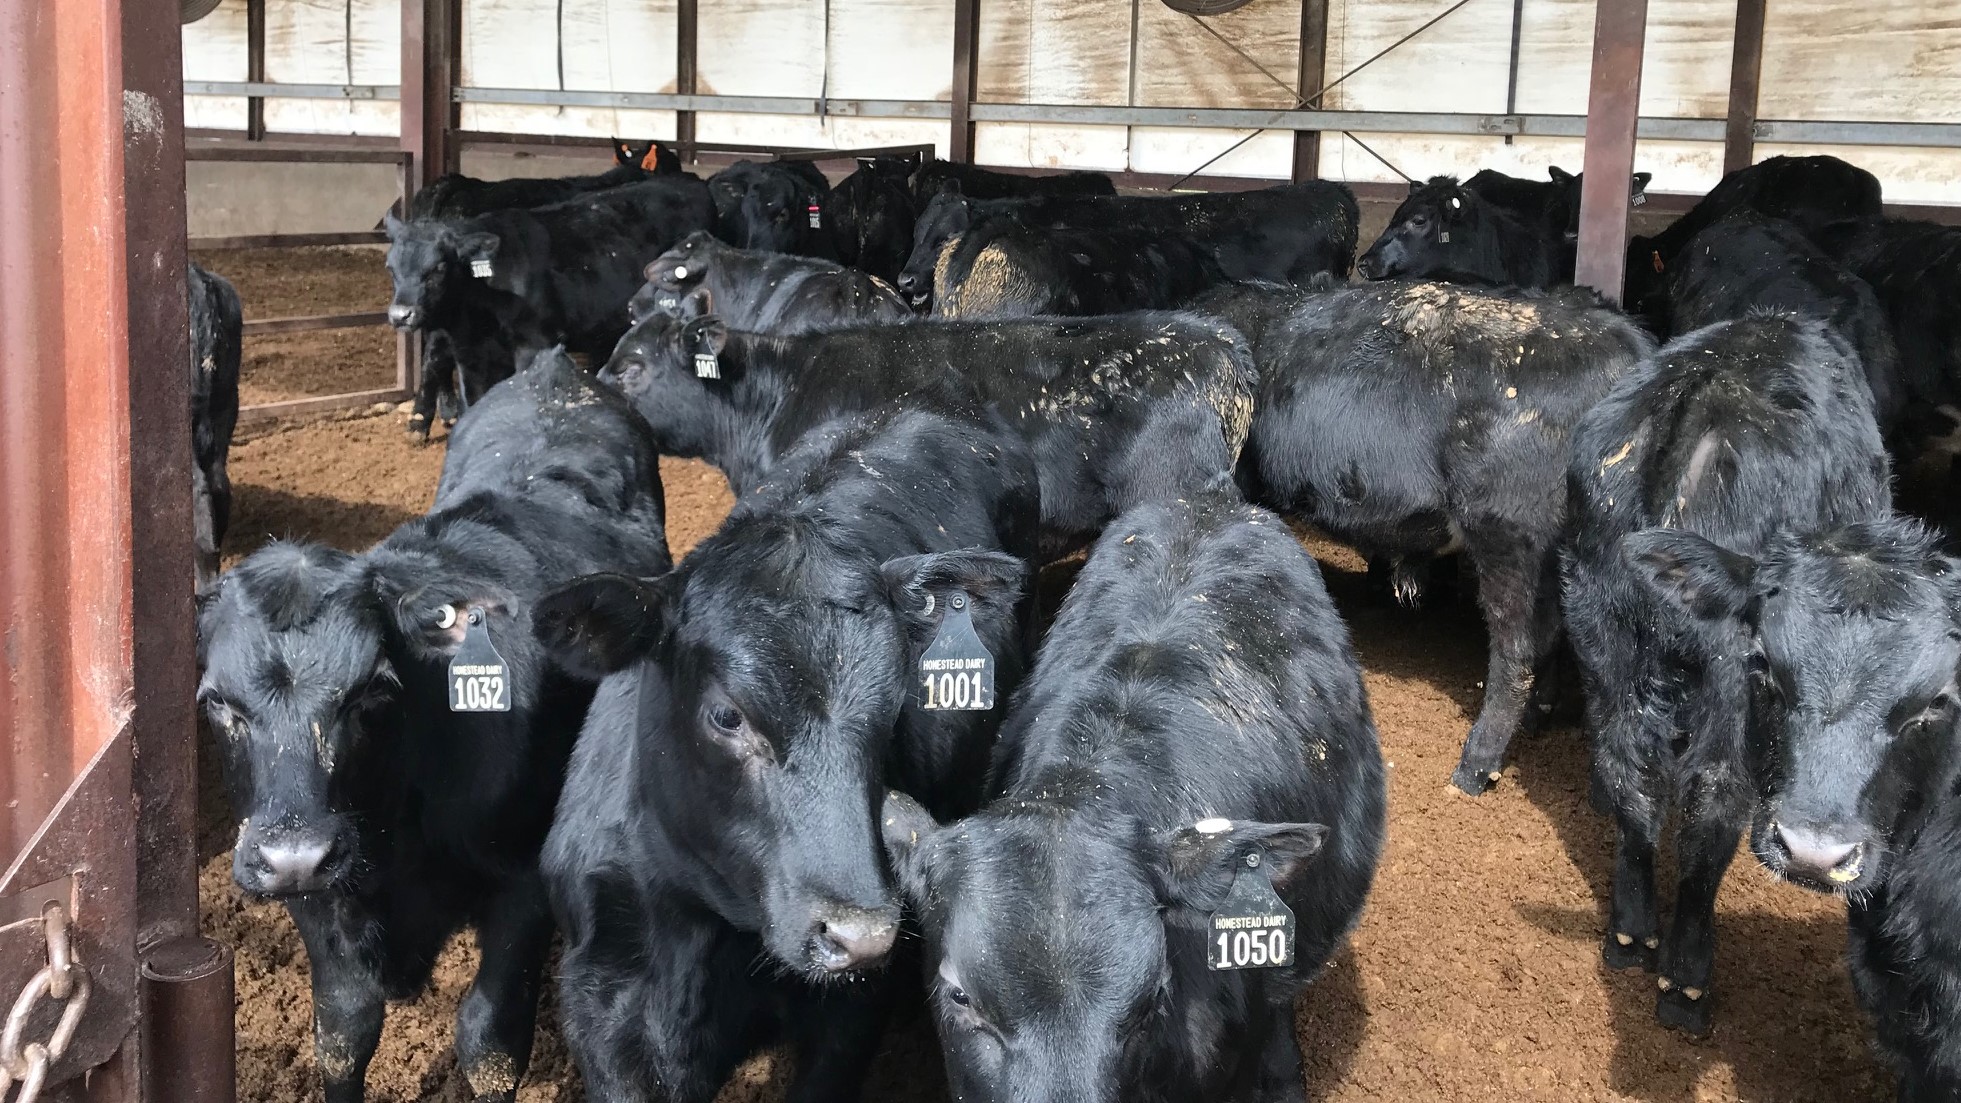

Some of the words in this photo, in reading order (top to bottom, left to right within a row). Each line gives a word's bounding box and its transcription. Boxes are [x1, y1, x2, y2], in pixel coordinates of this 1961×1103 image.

[696, 360, 716, 378] 1047
[923, 659, 964, 671] HOMESTEAD
[965, 658, 986, 669] DAIRY
[454, 676, 505, 709] 1032
[923, 672, 985, 709] 1001
[1215, 917, 1262, 929] HOMESTEAD
[1263, 915, 1287, 927] DAIRY
[1216, 929, 1286, 969] 1050
